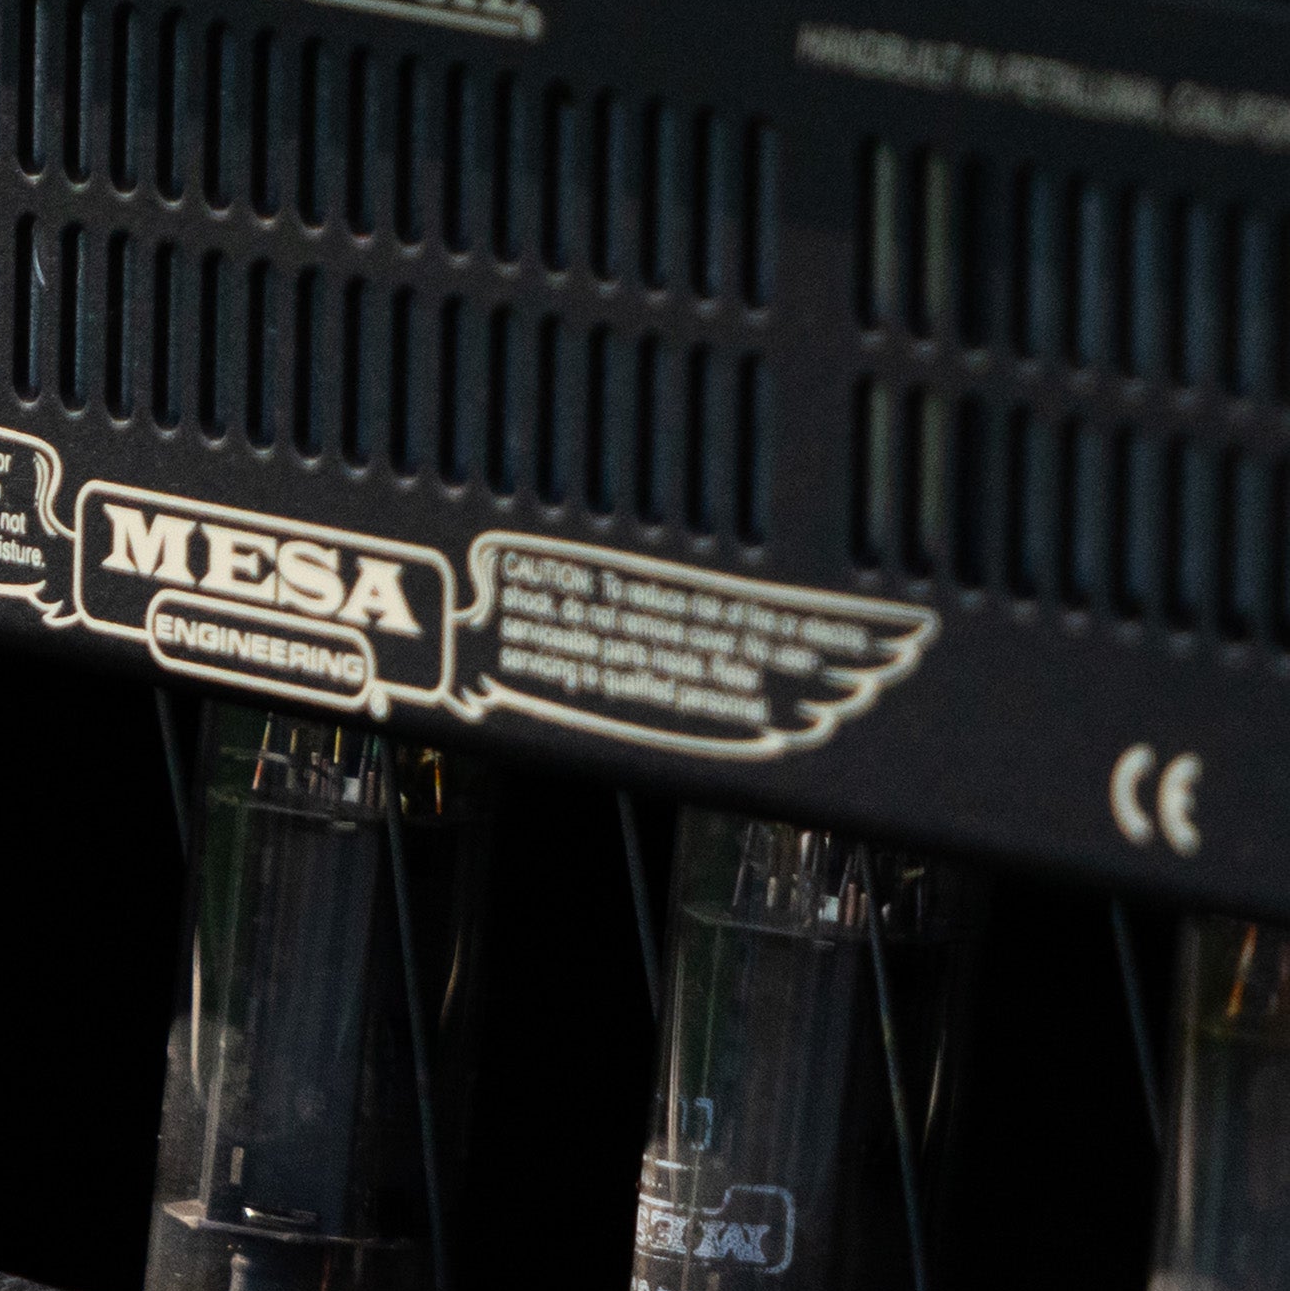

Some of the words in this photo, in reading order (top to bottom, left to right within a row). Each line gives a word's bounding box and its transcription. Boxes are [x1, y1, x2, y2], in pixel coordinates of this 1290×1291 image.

[0, 511, 27, 535] not
[101, 503, 422, 637] MESA
[154, 613, 365, 685] ENGINEERING
